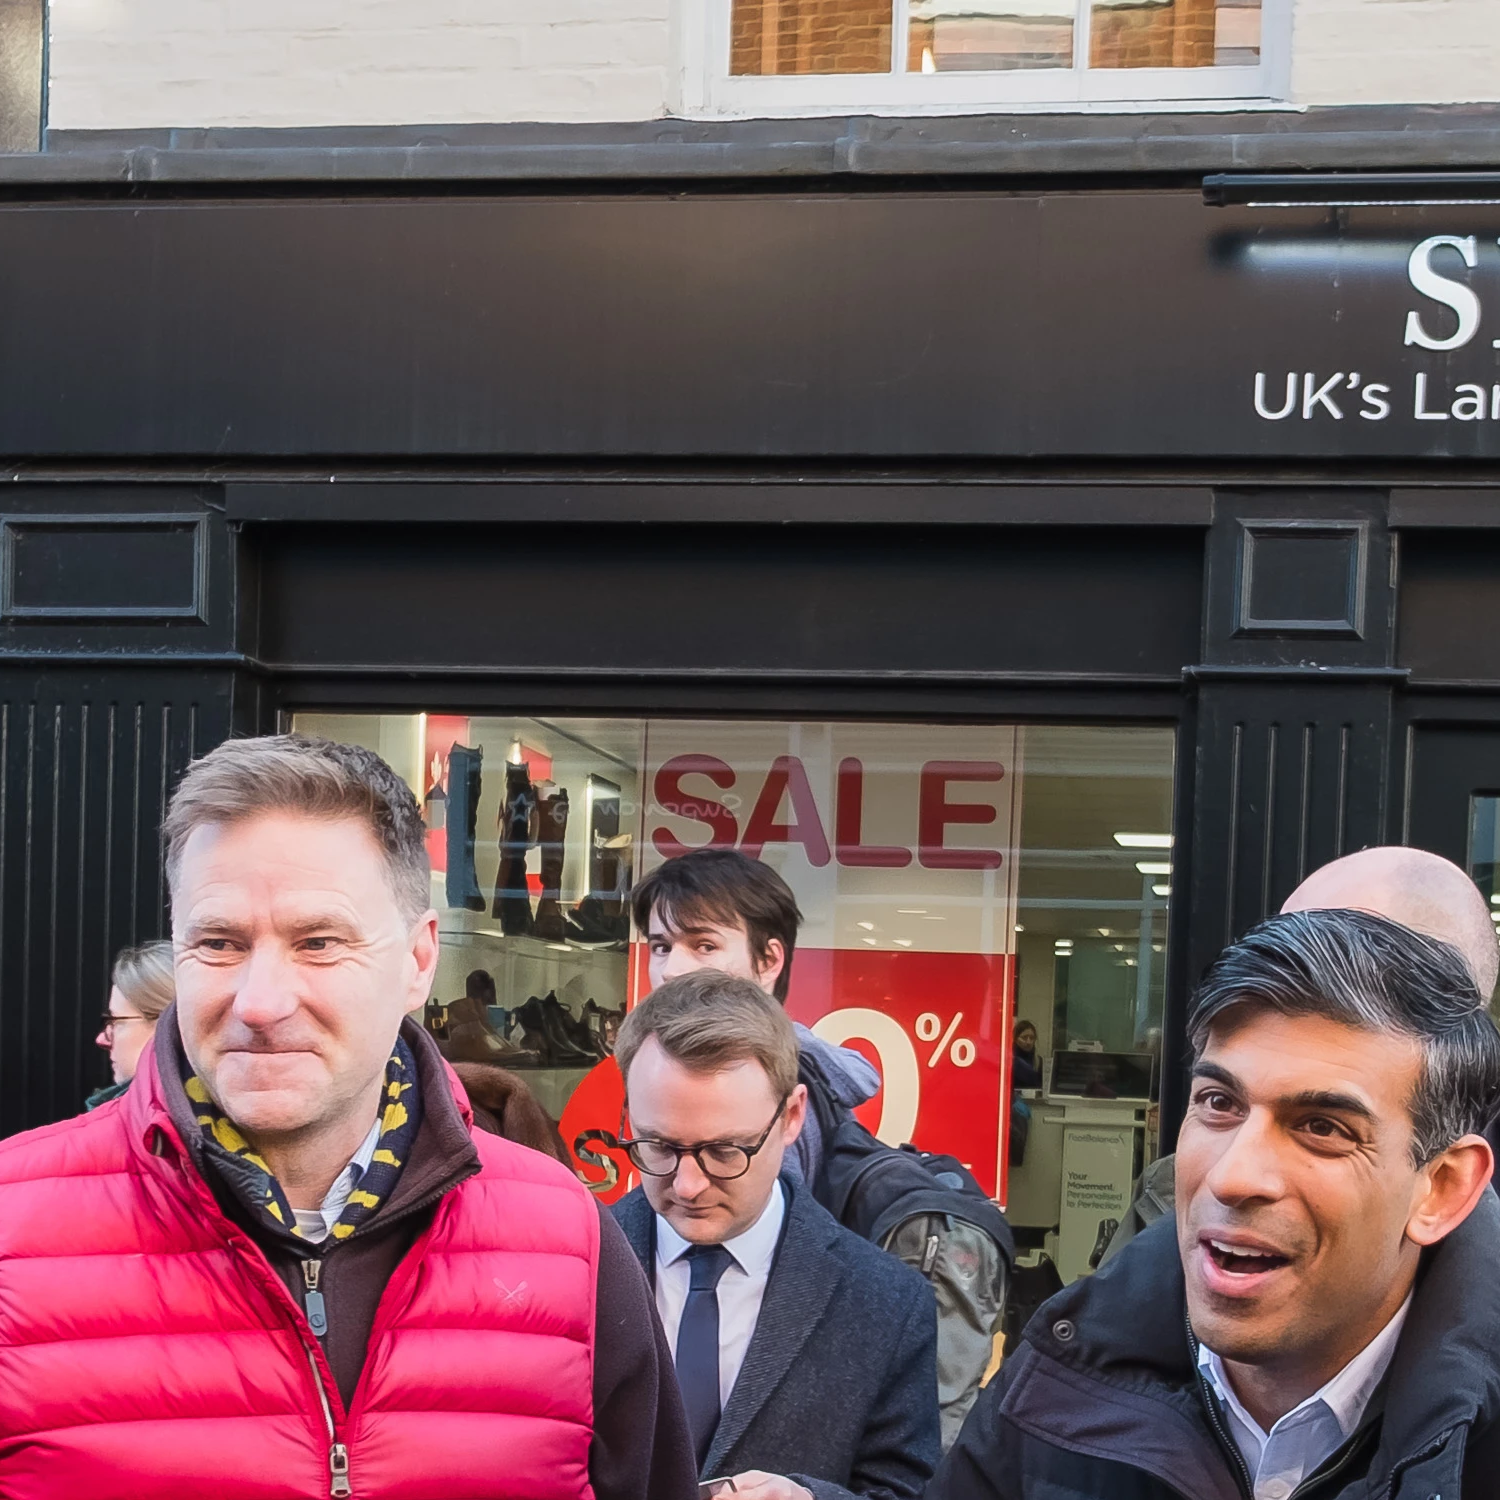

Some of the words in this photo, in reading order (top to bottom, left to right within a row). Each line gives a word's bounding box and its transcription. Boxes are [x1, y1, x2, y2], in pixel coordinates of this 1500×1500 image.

[1254, 372, 1390, 421] UK's
[652, 753, 1004, 870] SALE
[1068, 1172, 1087, 1180] Your
